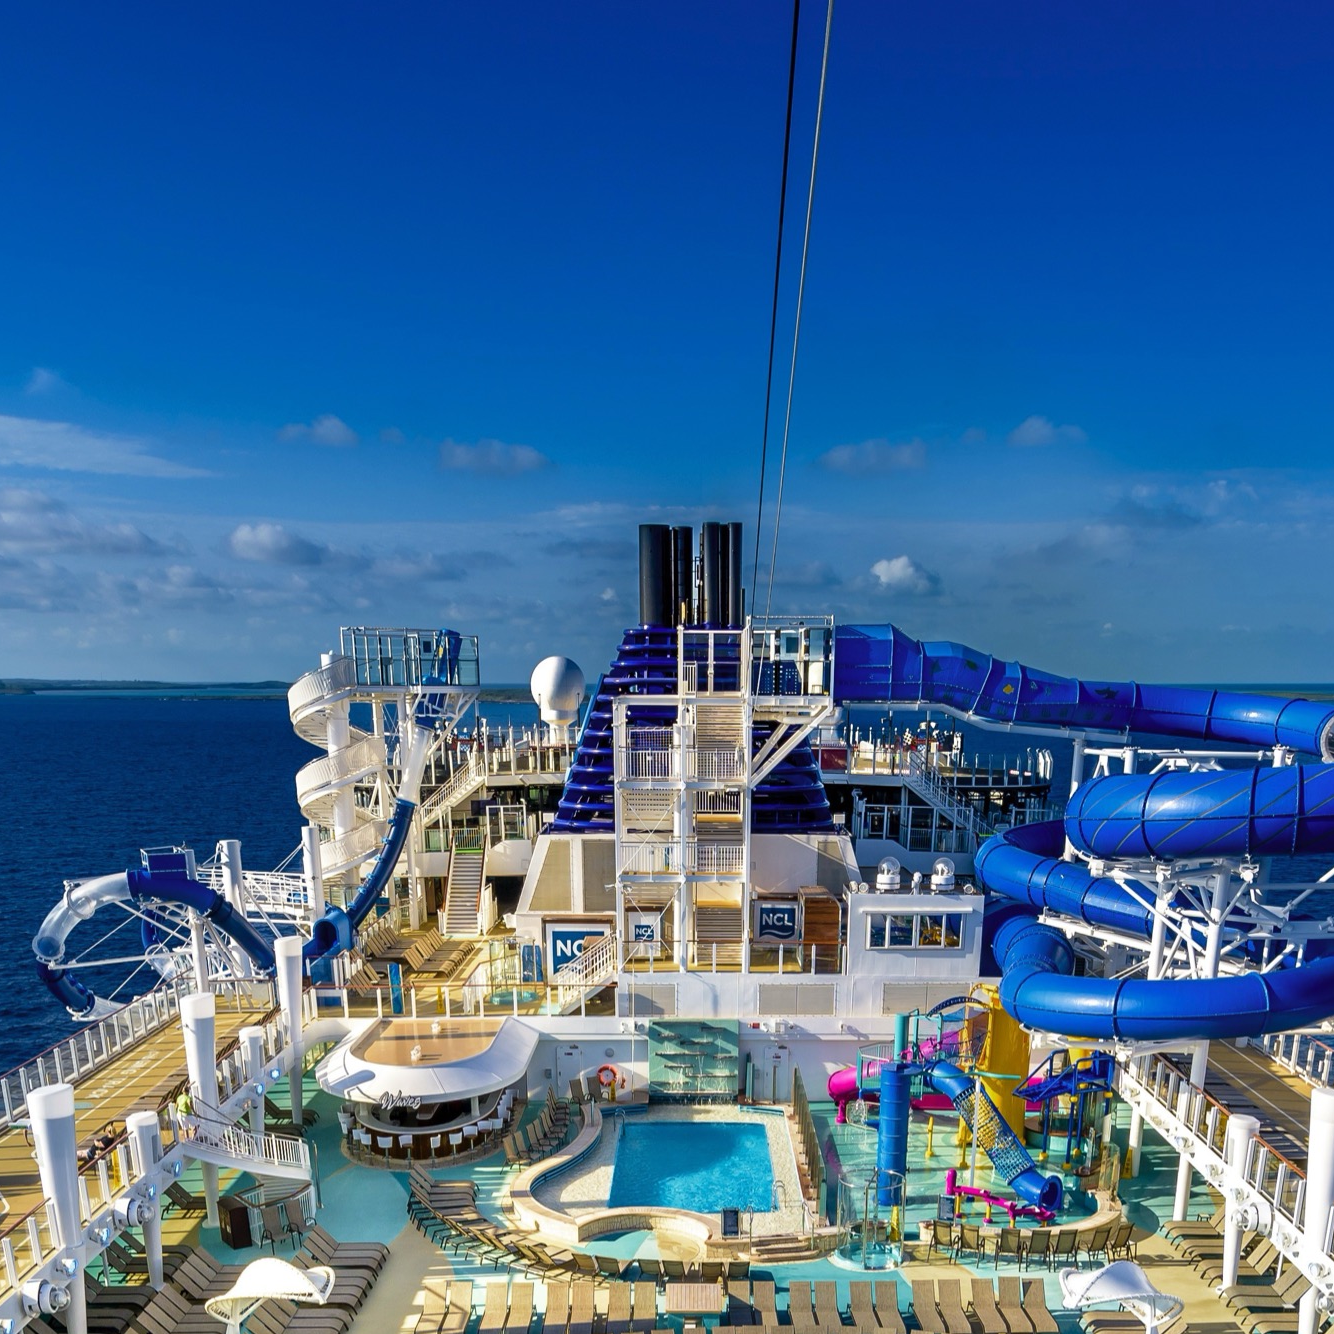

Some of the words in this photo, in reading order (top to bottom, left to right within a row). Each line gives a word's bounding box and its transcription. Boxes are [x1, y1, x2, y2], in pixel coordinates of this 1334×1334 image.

[762, 913, 793, 926] NCL
[635, 927, 654, 936] NCL
[556, 939, 585, 958] NC
[378, 1089, 422, 1111] Waves
